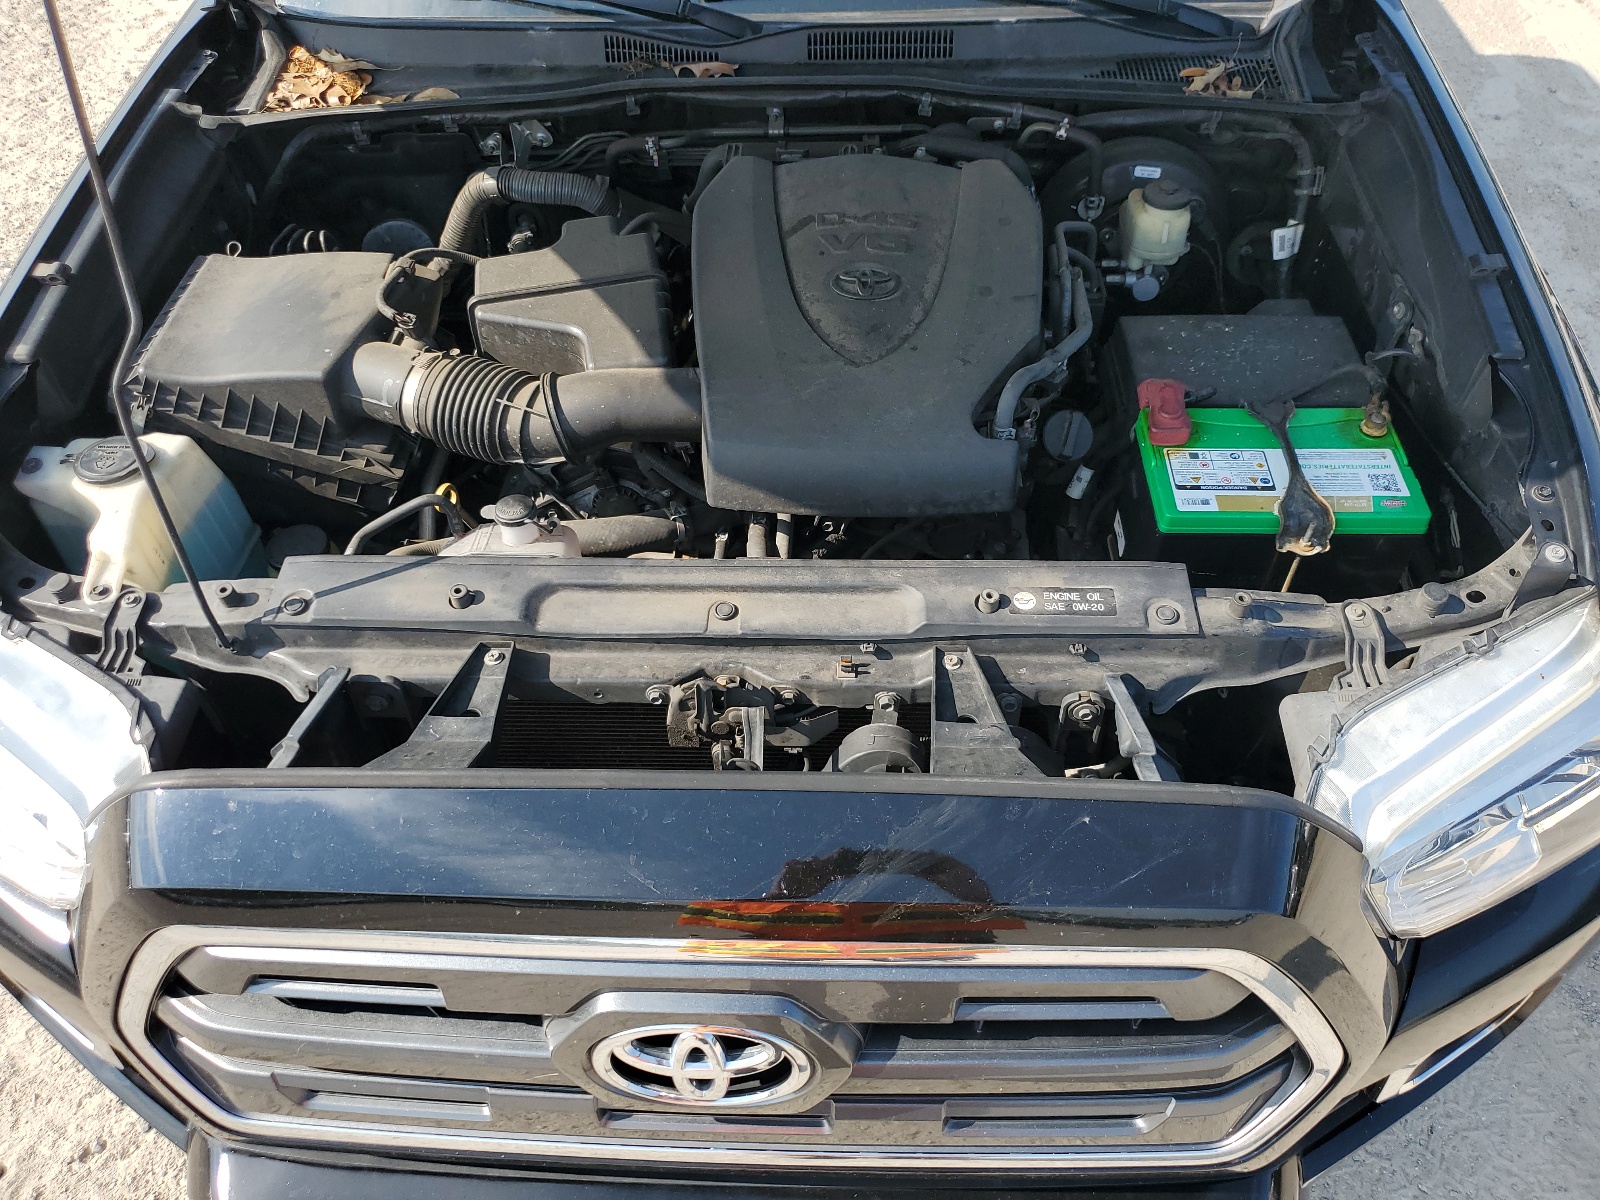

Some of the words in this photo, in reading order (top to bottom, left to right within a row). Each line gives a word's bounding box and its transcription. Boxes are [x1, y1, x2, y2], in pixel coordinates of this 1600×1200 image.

[818, 232, 914, 255] V6
[1043, 592, 1080, 600] ENGINE
[1086, 592, 1104, 601] OIL
[1044, 603, 1065, 611] SAE
[1072, 603, 1104, 611] 0W-20
